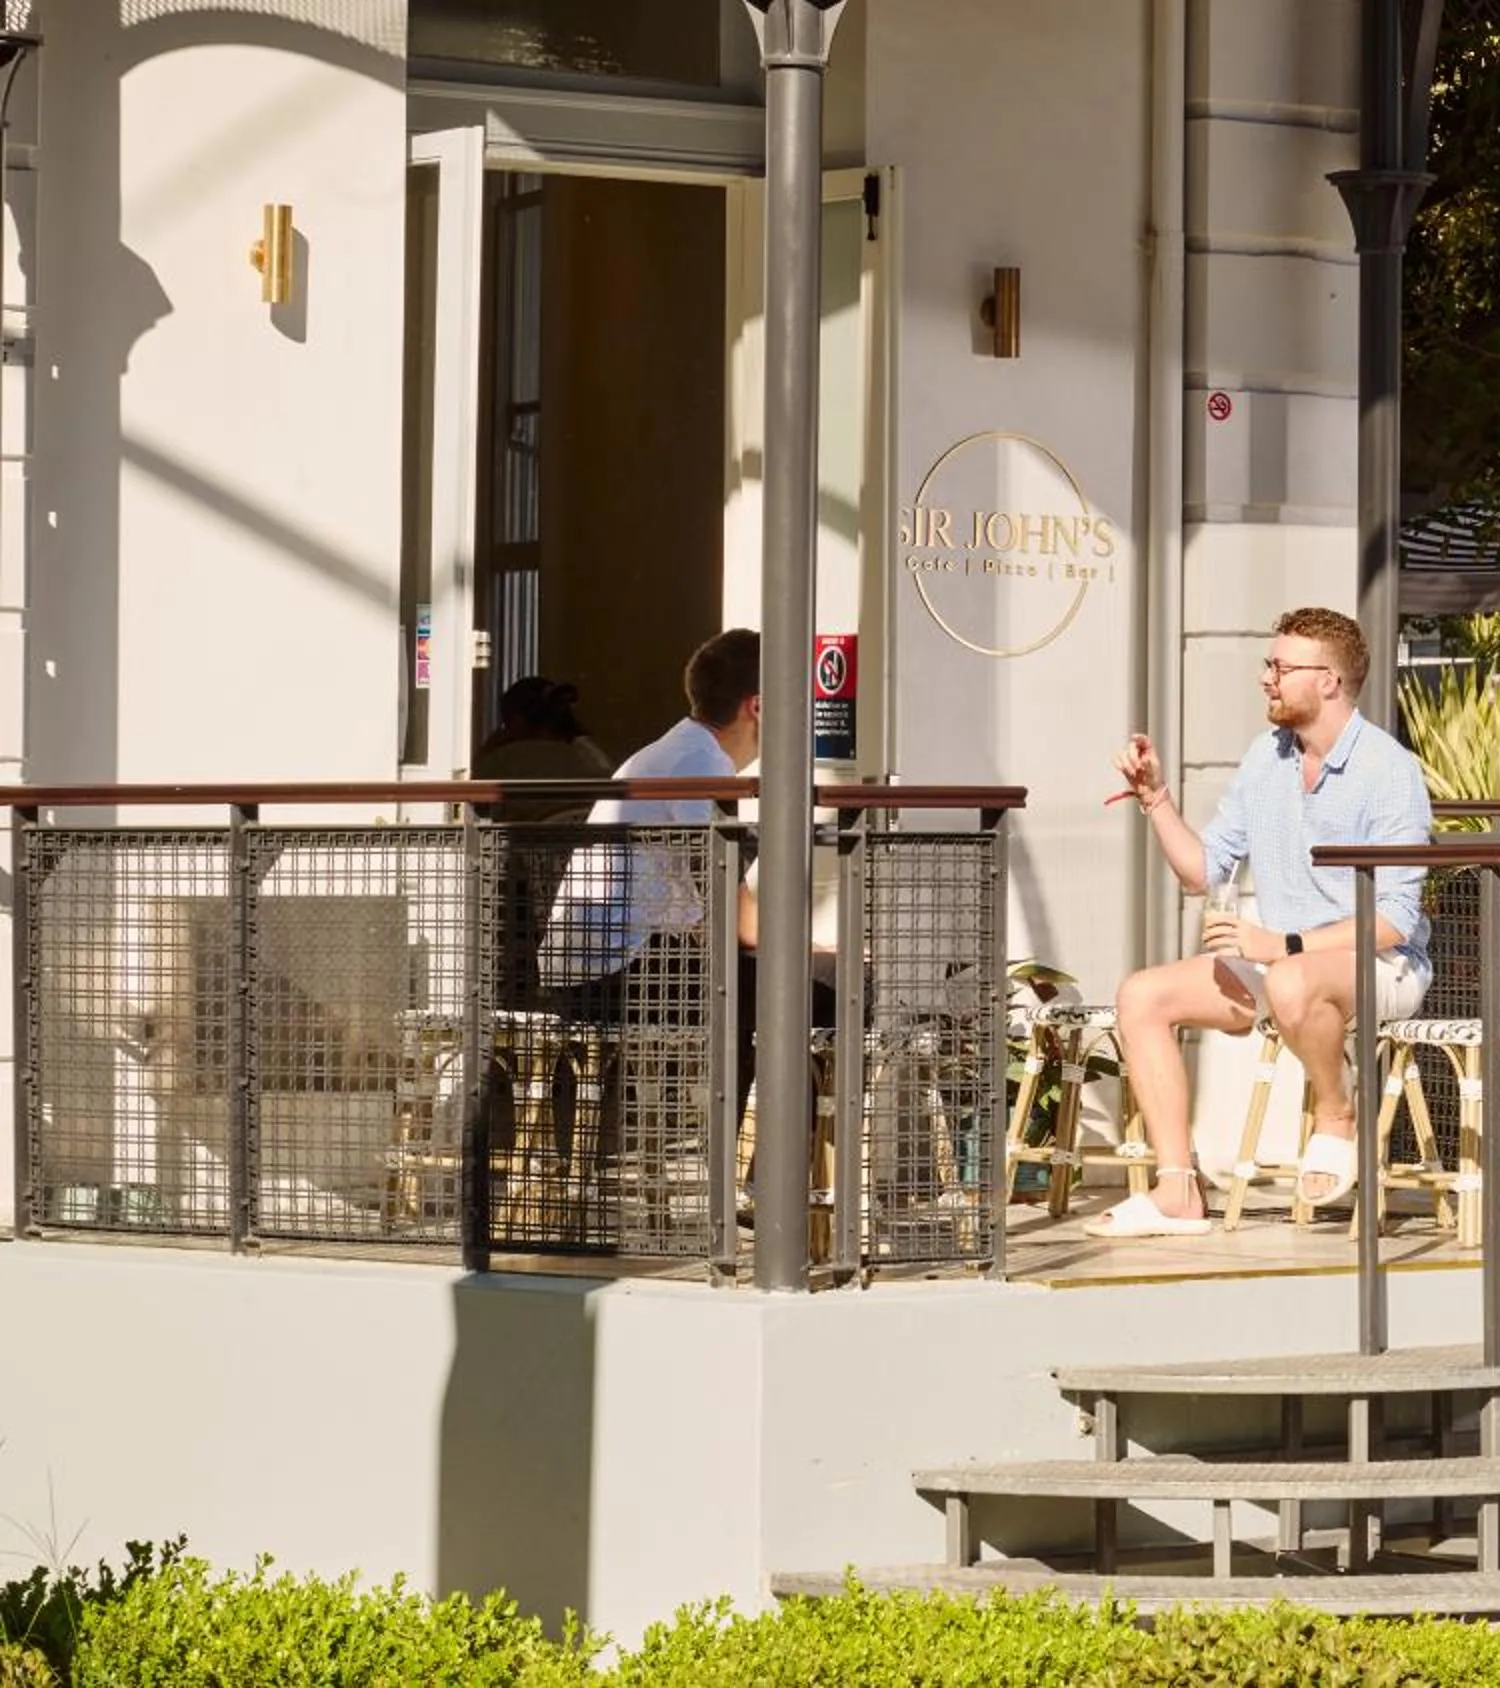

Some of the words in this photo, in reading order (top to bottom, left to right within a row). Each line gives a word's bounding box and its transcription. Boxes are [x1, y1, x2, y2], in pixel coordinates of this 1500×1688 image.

[961, 510, 1115, 558] JOHN'S
[983, 558, 1038, 577] Pizza
[1065, 563, 1098, 579] Bar
